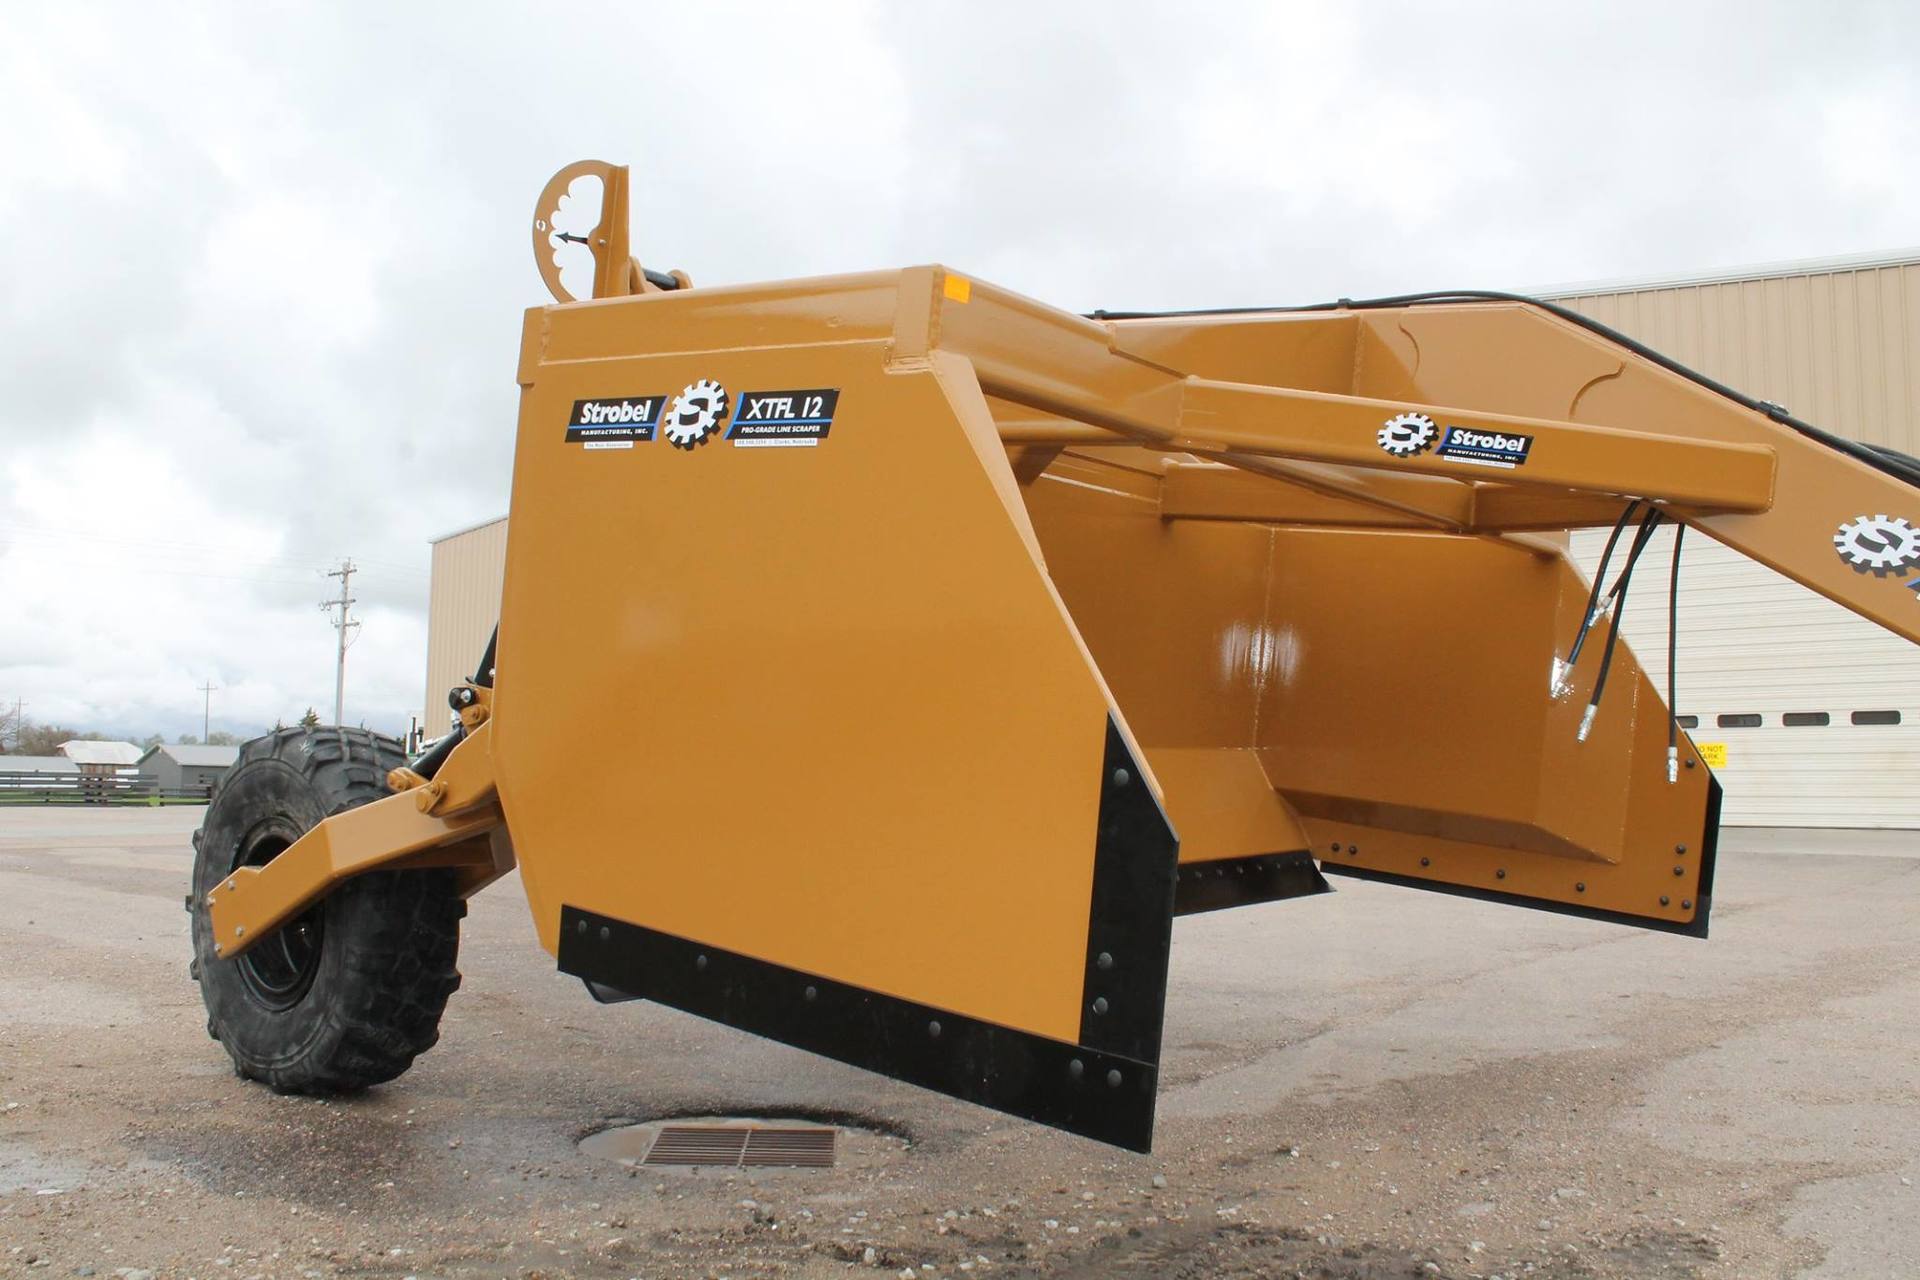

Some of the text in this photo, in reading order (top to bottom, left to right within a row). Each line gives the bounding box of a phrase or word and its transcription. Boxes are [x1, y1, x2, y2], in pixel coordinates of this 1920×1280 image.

[580, 400, 652, 424] Strobel
[745, 396, 823, 420] XTFL 12
[741, 425, 820, 434] PRO-GRADE LINE SCRAPER
[1450, 429, 1526, 452] Strobel
